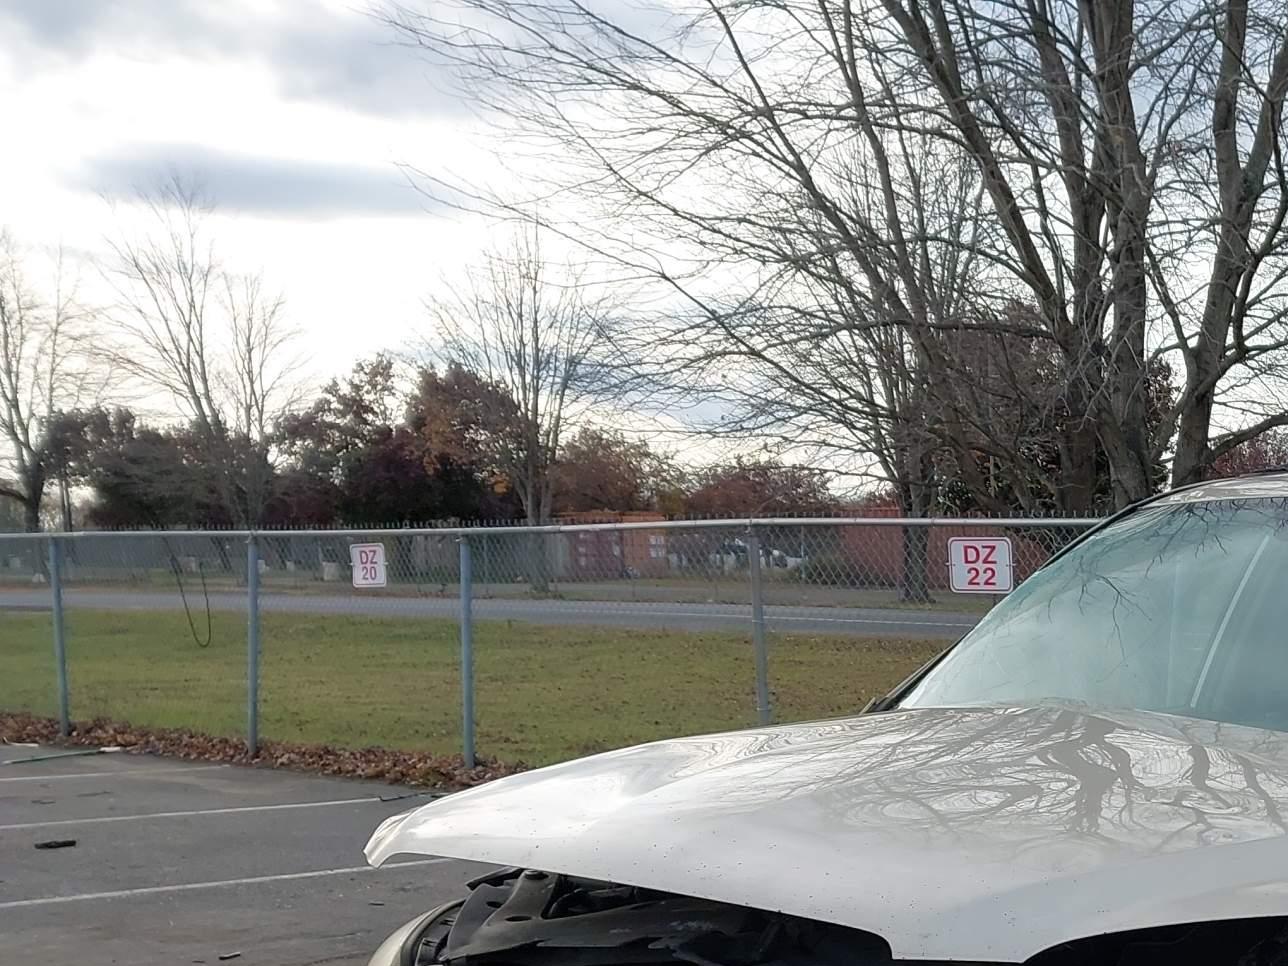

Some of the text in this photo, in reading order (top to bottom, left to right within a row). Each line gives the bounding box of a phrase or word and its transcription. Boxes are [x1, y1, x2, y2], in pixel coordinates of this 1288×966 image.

[359, 550, 378, 565] DZ
[963, 545, 997, 565] DZ
[362, 566, 377, 581] 20
[967, 567, 996, 586] 22
